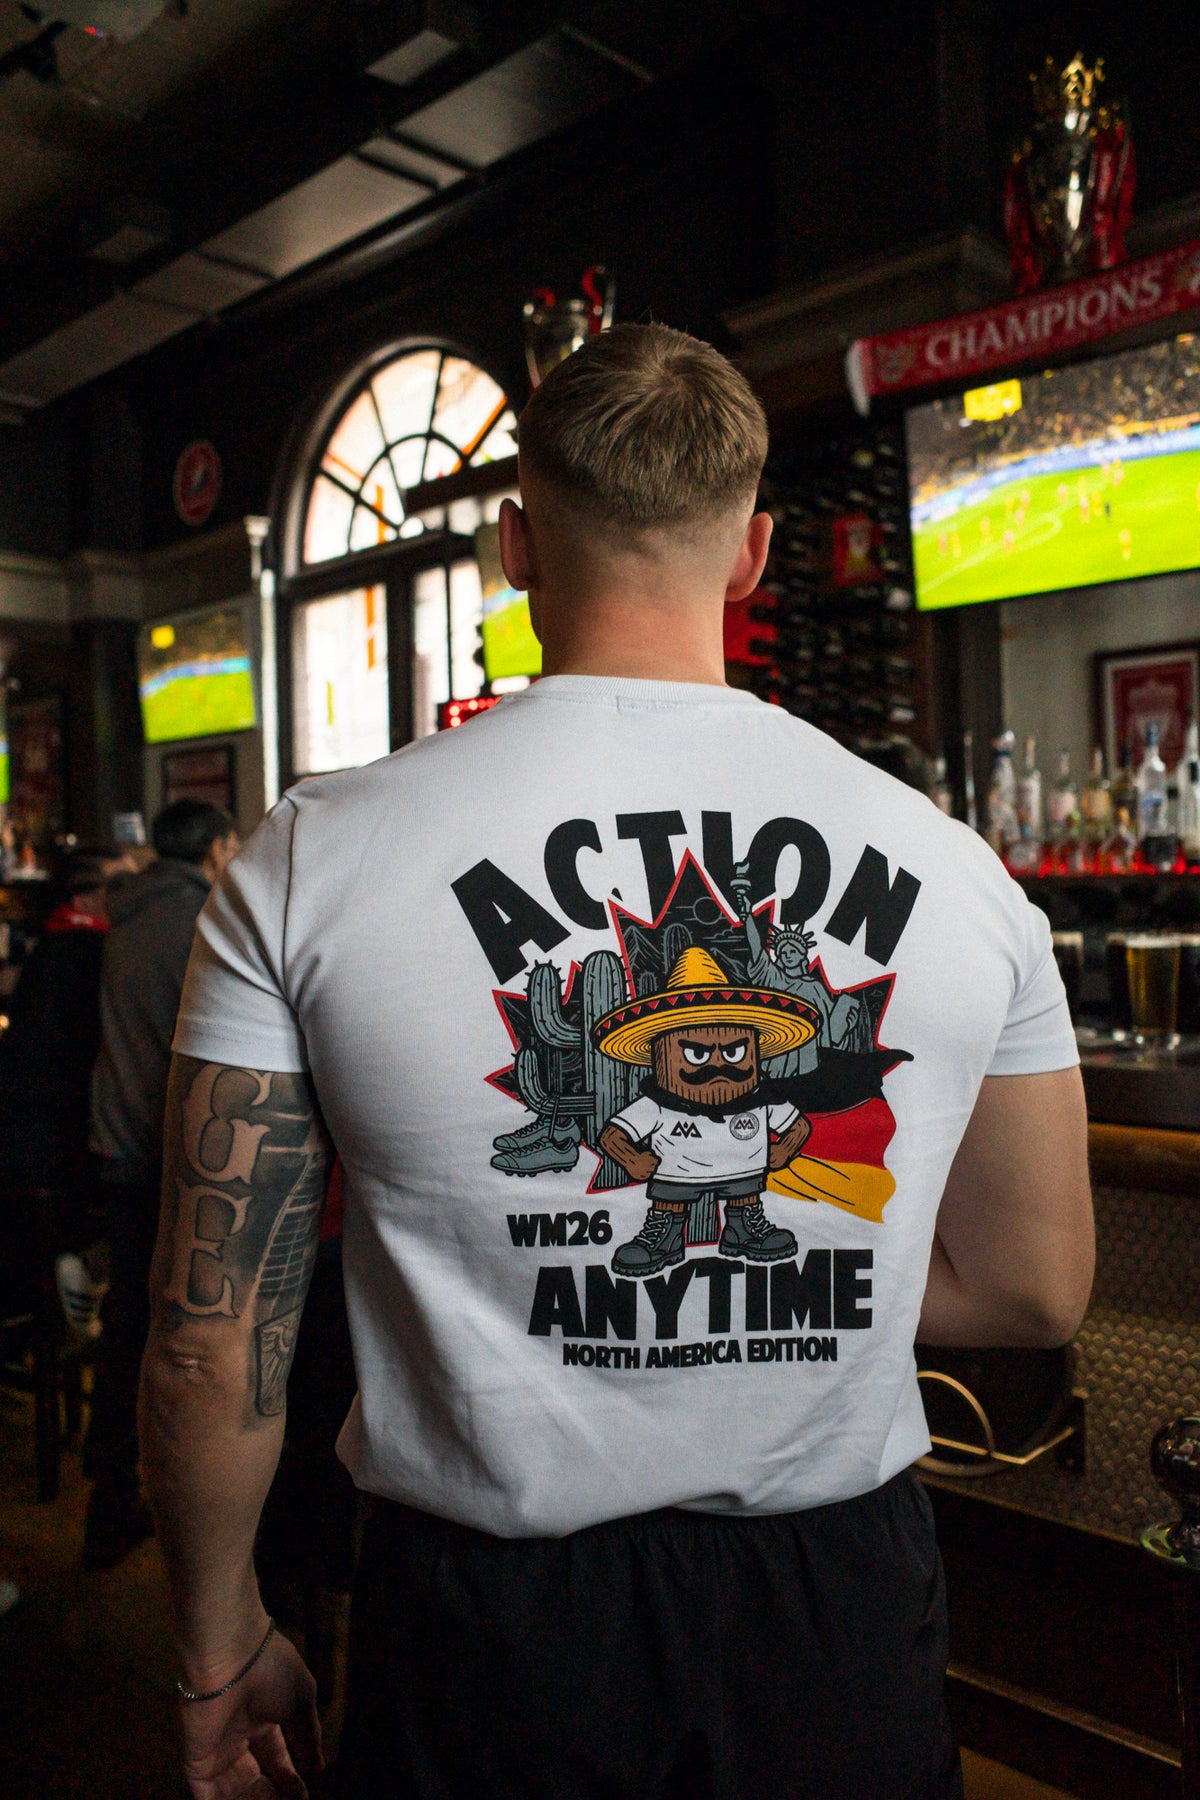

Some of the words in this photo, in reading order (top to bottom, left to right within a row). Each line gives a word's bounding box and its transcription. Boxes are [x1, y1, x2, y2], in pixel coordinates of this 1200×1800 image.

[924, 264, 1162, 366] CHAMPIONS
[450, 809, 923, 987] ACTION
[506, 1209, 613, 1248] WM26
[527, 1248, 874, 1341] ANYTIME
[562, 1342, 641, 1370] NORTH
[645, 1339, 743, 1369] AMERICA
[747, 1336, 838, 1363] EDITION
